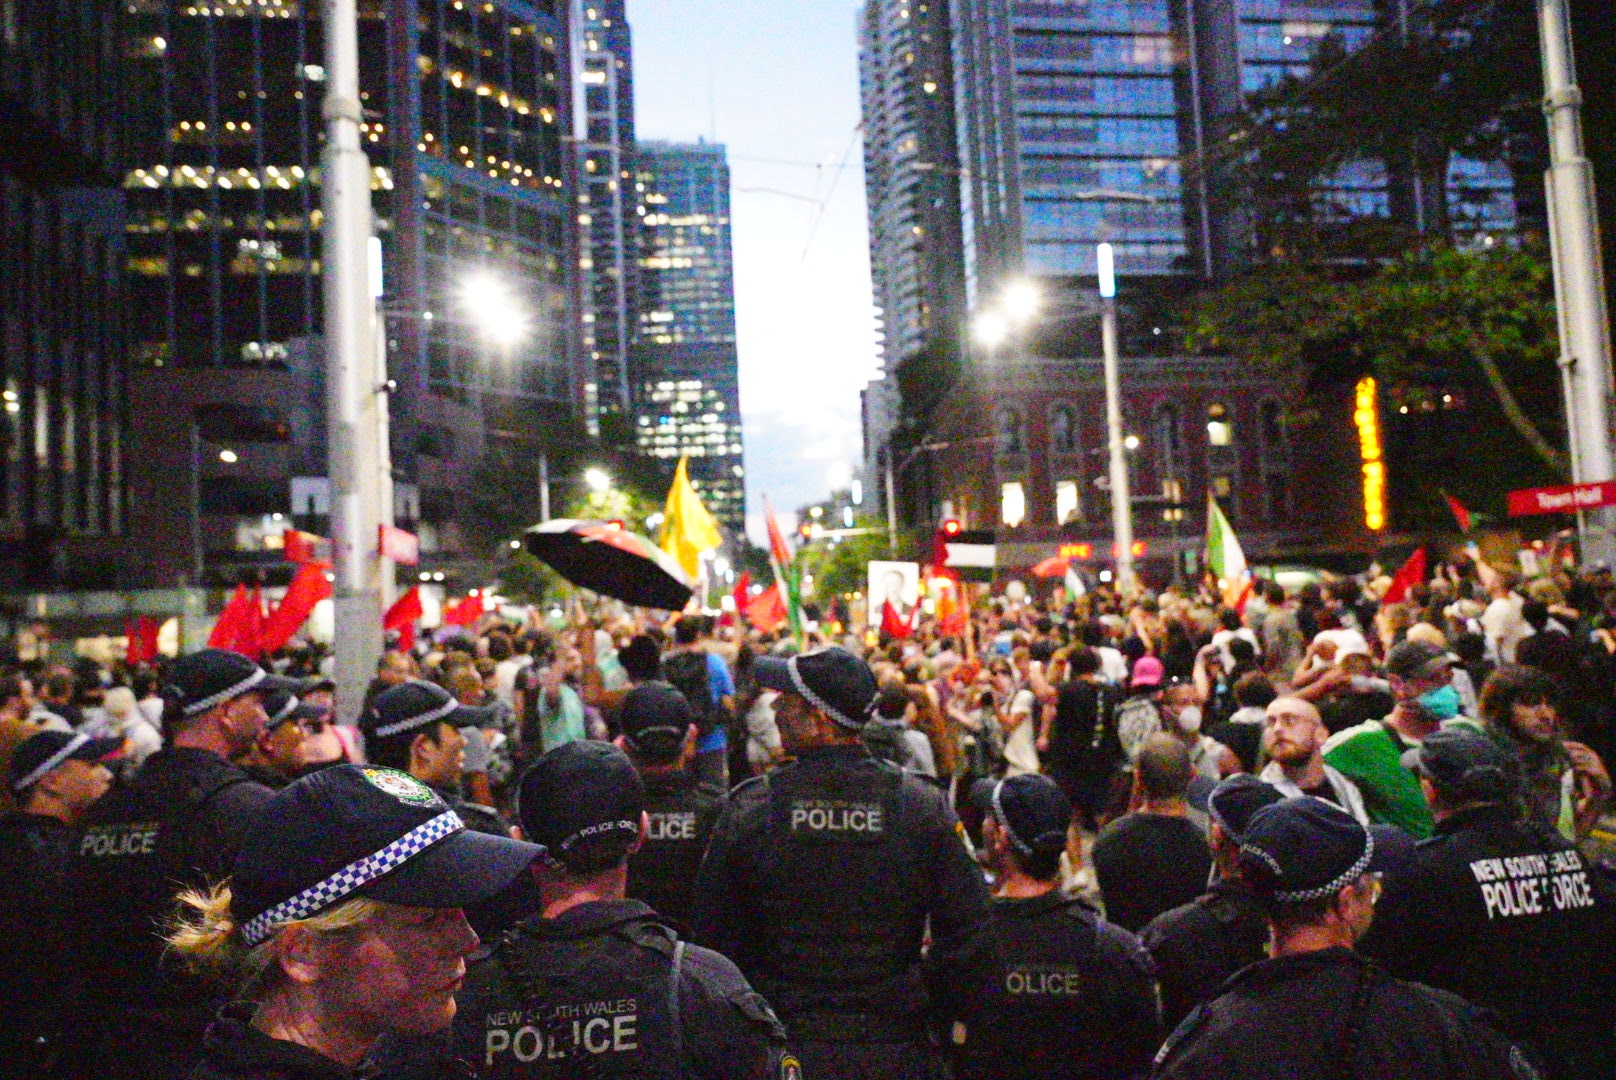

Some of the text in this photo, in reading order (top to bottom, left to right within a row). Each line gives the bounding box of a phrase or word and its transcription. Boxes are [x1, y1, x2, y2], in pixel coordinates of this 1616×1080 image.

[580, 821, 614, 838] POLICE
[648, 820, 696, 839] LICE
[791, 808, 883, 832] POLICE
[80, 831, 158, 856] POLICE
[1469, 858, 1507, 882] NEW
[1504, 854, 1548, 878] SOUTH
[1480, 878, 1542, 919] POLICE
[486, 1011, 522, 1026] NEW
[584, 998, 637, 1015] WALES
[485, 1015, 638, 1066] POLICE
